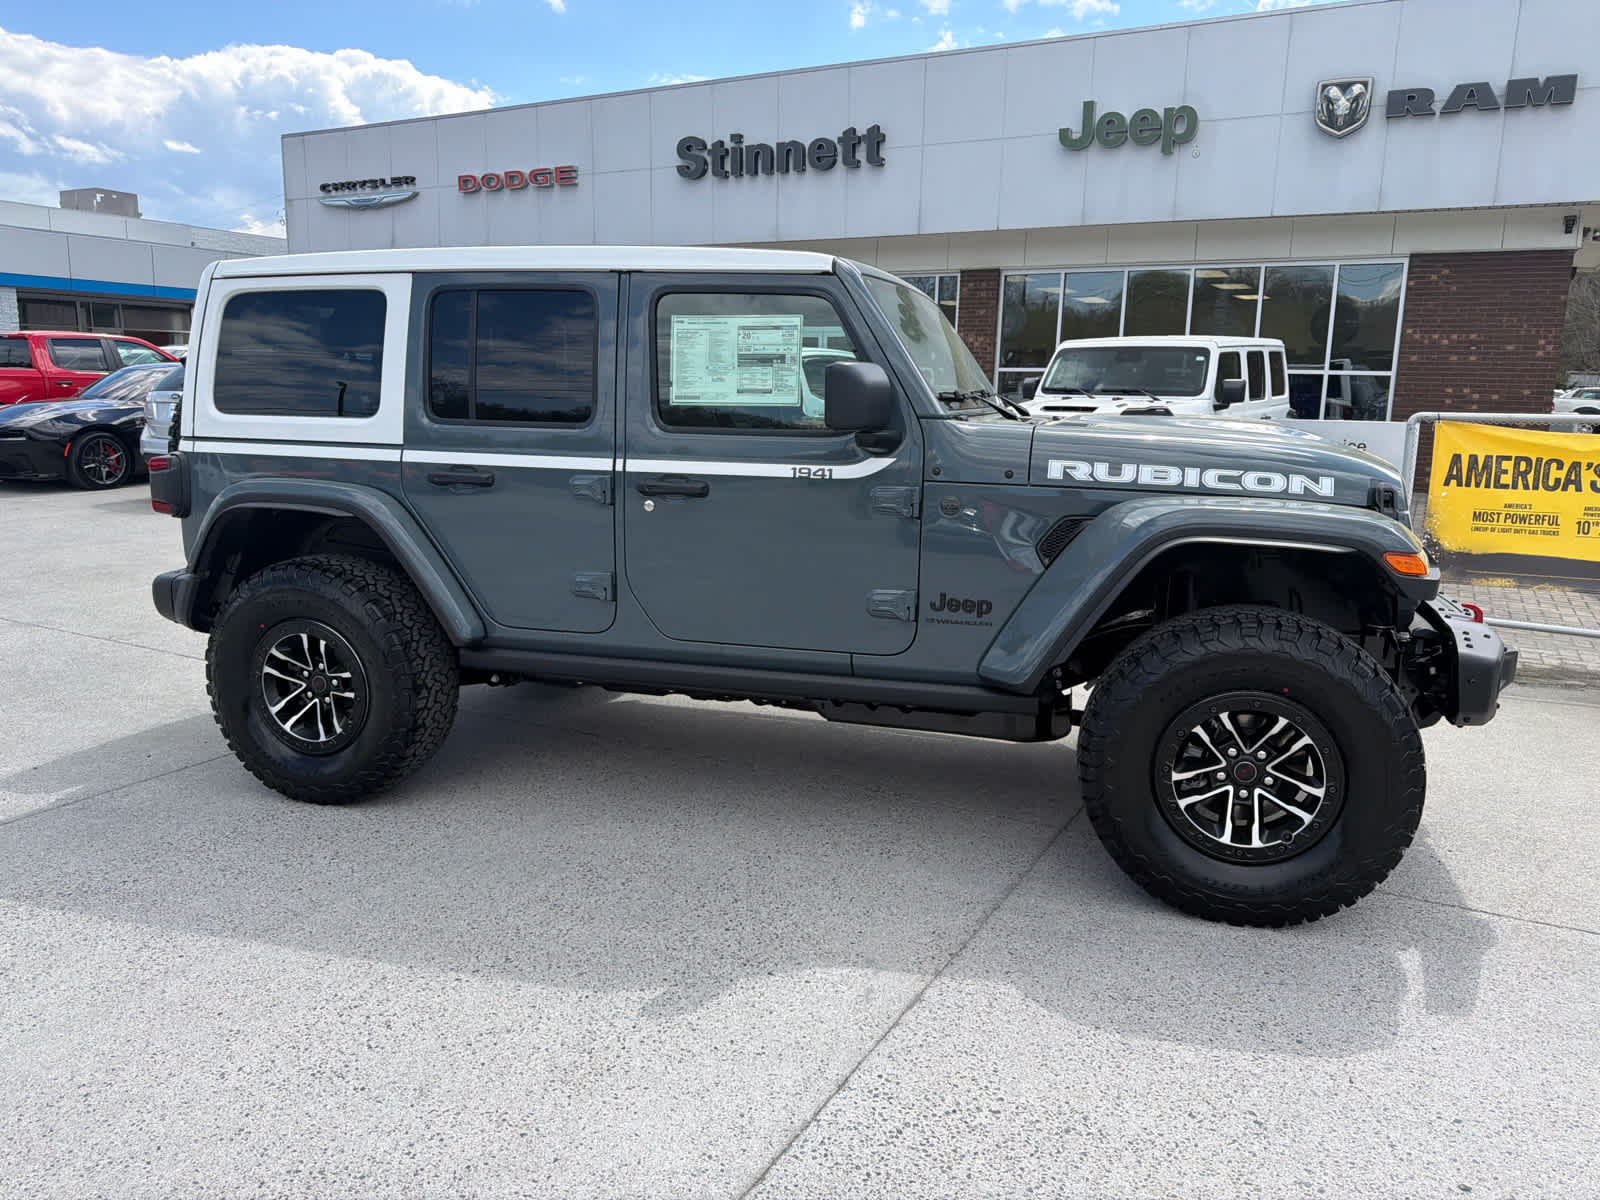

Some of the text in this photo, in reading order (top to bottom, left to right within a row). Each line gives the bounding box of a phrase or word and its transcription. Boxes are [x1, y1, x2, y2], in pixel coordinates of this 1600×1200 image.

[1385, 73, 1578, 118] RAM
[1058, 100, 1198, 156] Jeep
[676, 124, 886, 180] Stinnett
[319, 176, 416, 193] CHRYSLER
[457, 165, 578, 193] DODGE
[791, 467, 833, 480] 1941
[1047, 459, 1335, 497] RUBICON
[1472, 511, 1560, 526] MOST POWERFUL
[1576, 520, 1591, 535] 10
[929, 592, 992, 618] Jeep
